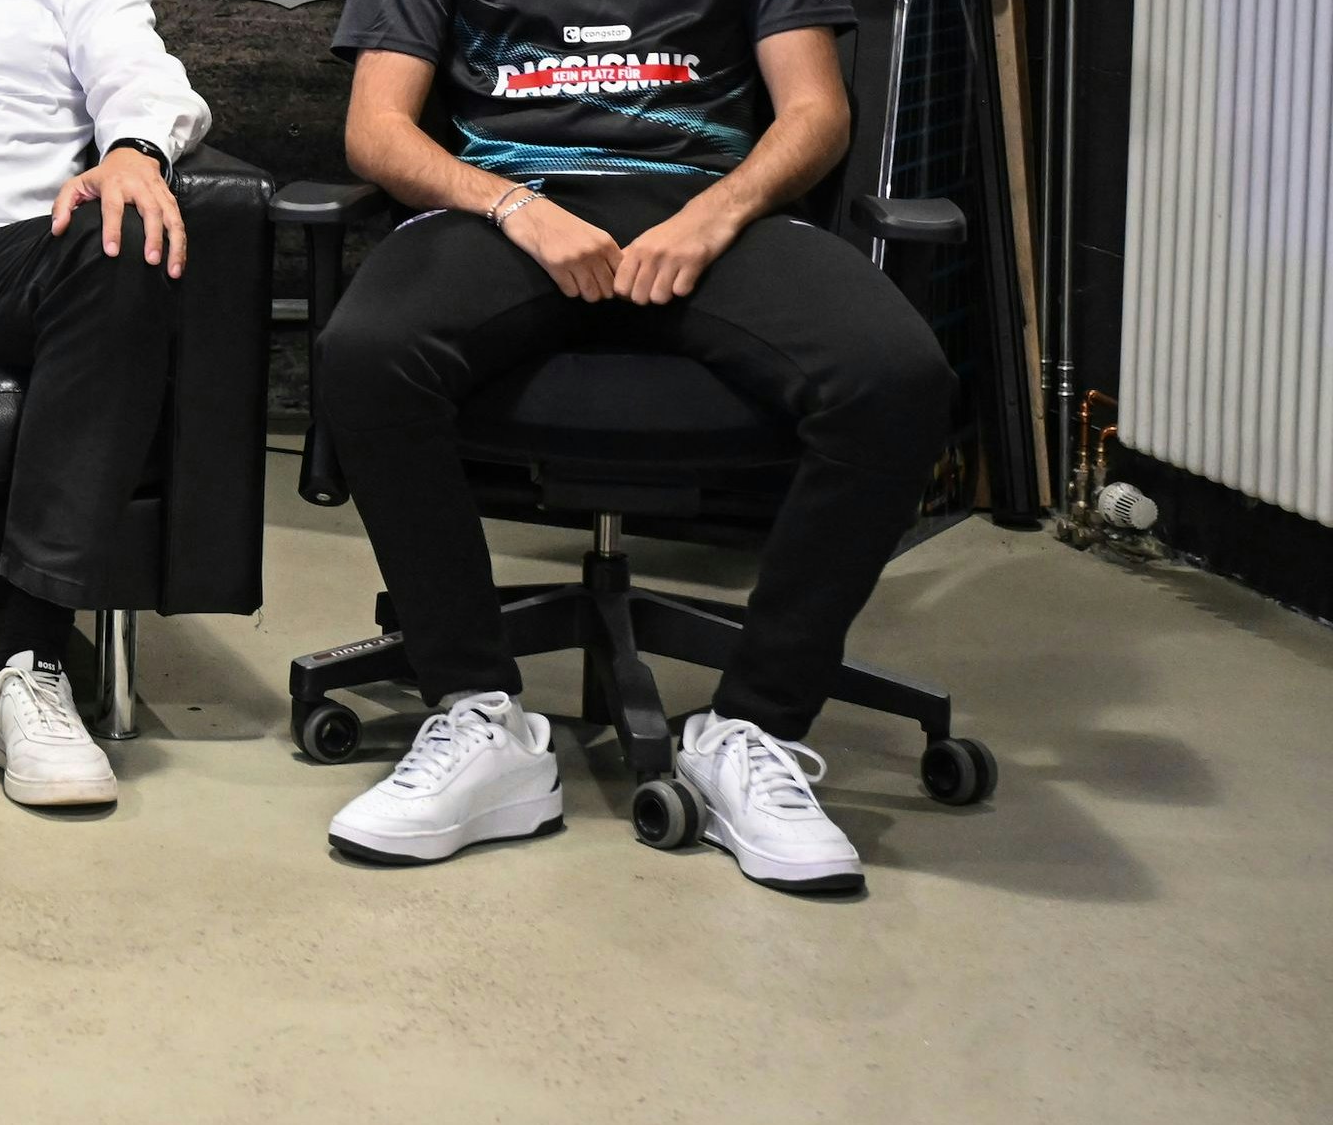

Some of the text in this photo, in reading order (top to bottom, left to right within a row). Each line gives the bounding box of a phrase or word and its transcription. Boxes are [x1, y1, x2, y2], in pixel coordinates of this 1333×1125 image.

[552, 66, 641, 83] KEIN PLATZ FÜR
[37, 660, 56, 671] BOSS
